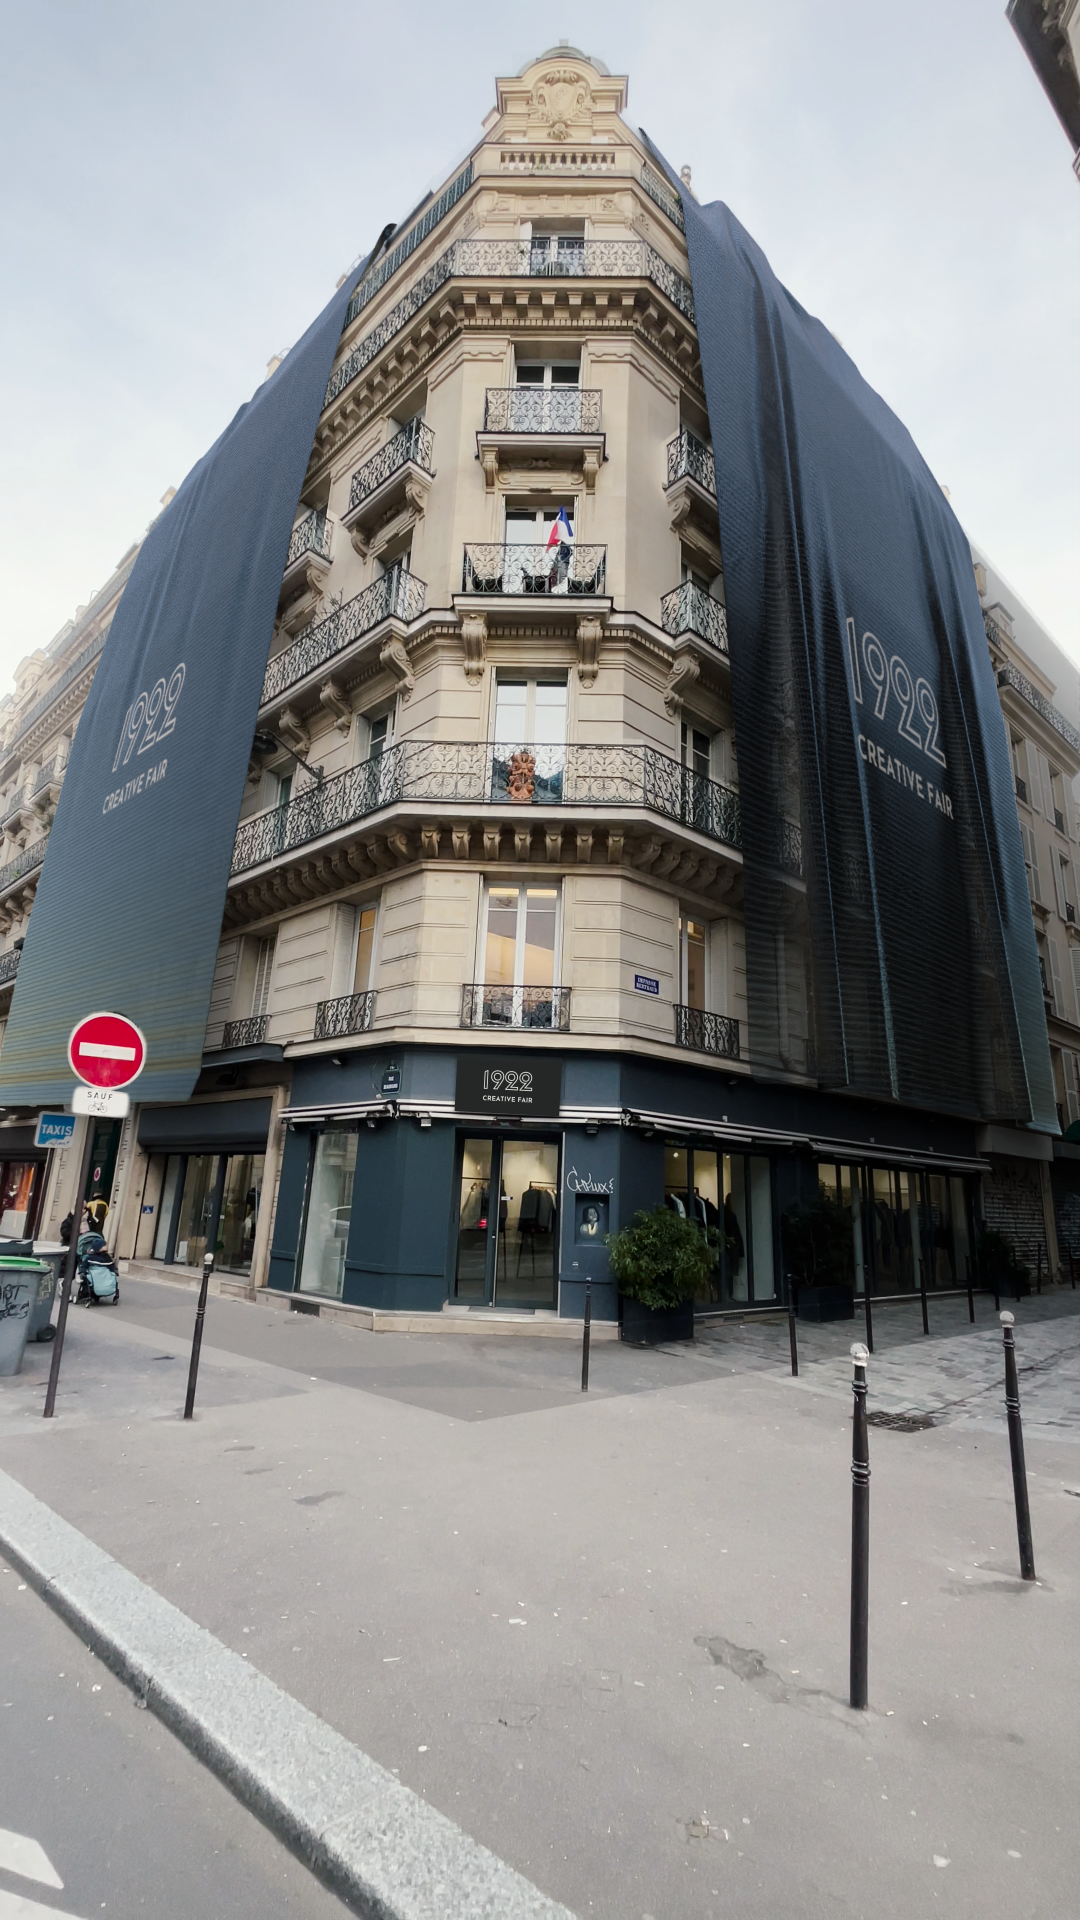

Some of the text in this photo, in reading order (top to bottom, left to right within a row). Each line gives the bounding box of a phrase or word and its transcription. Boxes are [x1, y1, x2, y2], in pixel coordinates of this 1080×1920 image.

[846, 617, 947, 768] 1922
[112, 662, 186, 773] 1922
[102, 758, 168, 814] CREATIVE FAIR
[857, 734, 954, 820] CREATIVE FAIR
[87, 1091, 113, 1100] SAUF
[482, 1095, 533, 1104] CREATIVE FAIR
[483, 1069, 533, 1092] 1922
[41, 1124, 72, 1136] TAXIS
